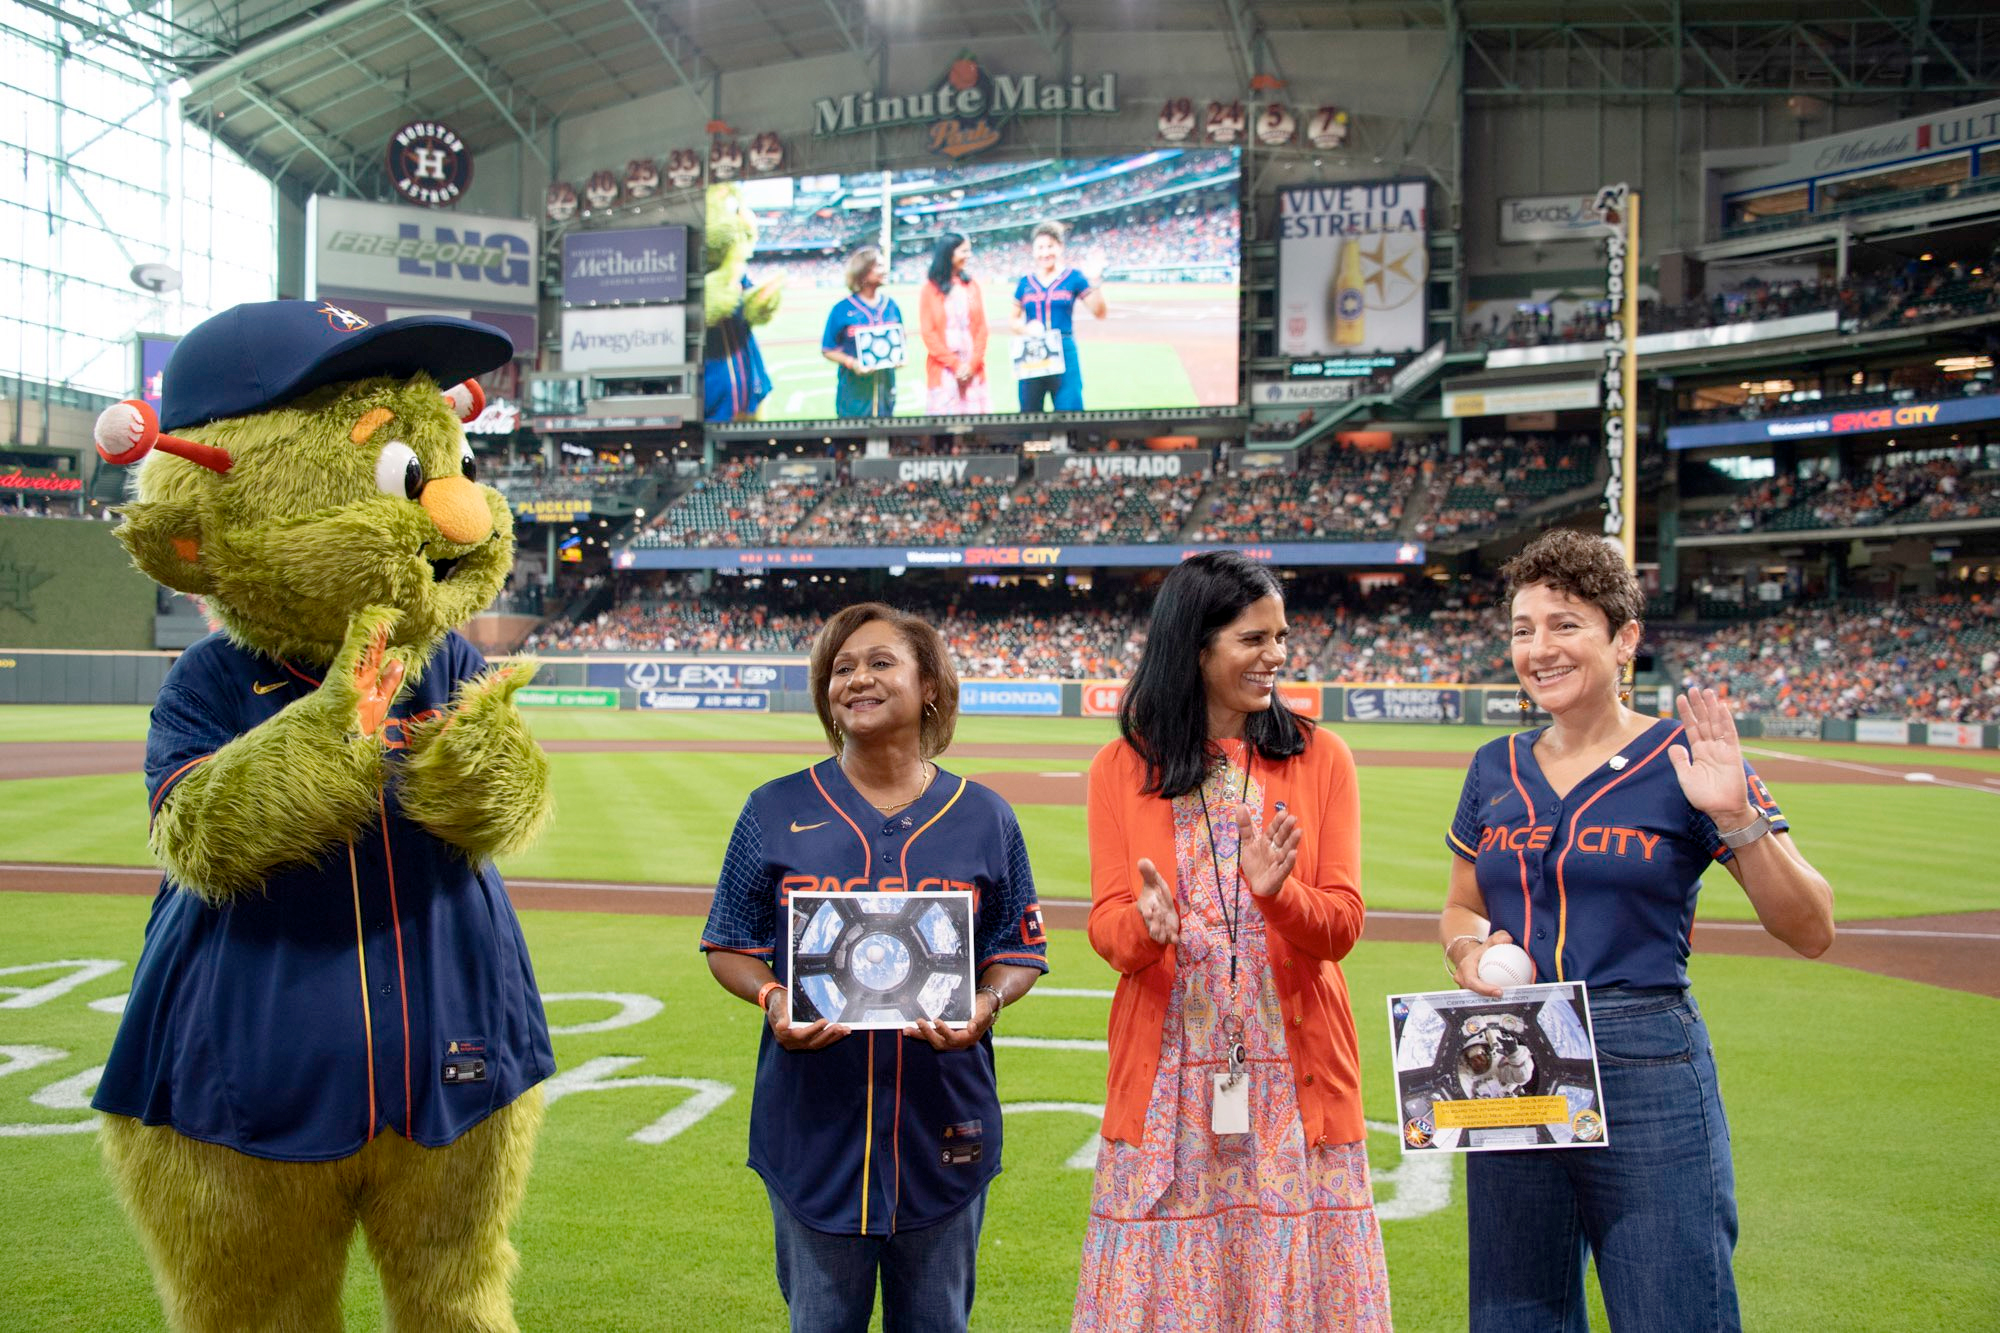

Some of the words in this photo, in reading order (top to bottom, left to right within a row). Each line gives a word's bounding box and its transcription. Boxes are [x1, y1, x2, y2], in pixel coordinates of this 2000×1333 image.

[815, 87, 982, 135] Minute
[993, 73, 1117, 111] Maid
[1208, 99, 1245, 125] 24
[1268, 103, 1282, 127] 5
[1319, 106, 1336, 132] 7
[396, 123, 464, 153] HOUSTON
[415, 146, 447, 180] H
[399, 178, 460, 203] ASTROS
[1365, 183, 1399, 209] TU
[1511, 202, 1569, 224] Texas
[335, 231, 502, 267] FREEPORT
[398, 222, 530, 287] LNG
[571, 249, 677, 278] Methodist
[1606, 236, 1626, 313] ROOT
[1832, 409, 1893, 432] SPACE
[1895, 404, 1940, 425] CITY
[900, 460, 968, 481] CHEVY
[517, 500, 592, 514] PLUCKERS
[964, 547, 1019, 564] SPACE
[1022, 547, 1061, 564] CITY
[980, 691, 1058, 705] HONDA
[1382, 689, 1440, 703] ENERGY
[1384, 702, 1457, 719] TRANSFR
[1576, 826, 1661, 862] CITY
